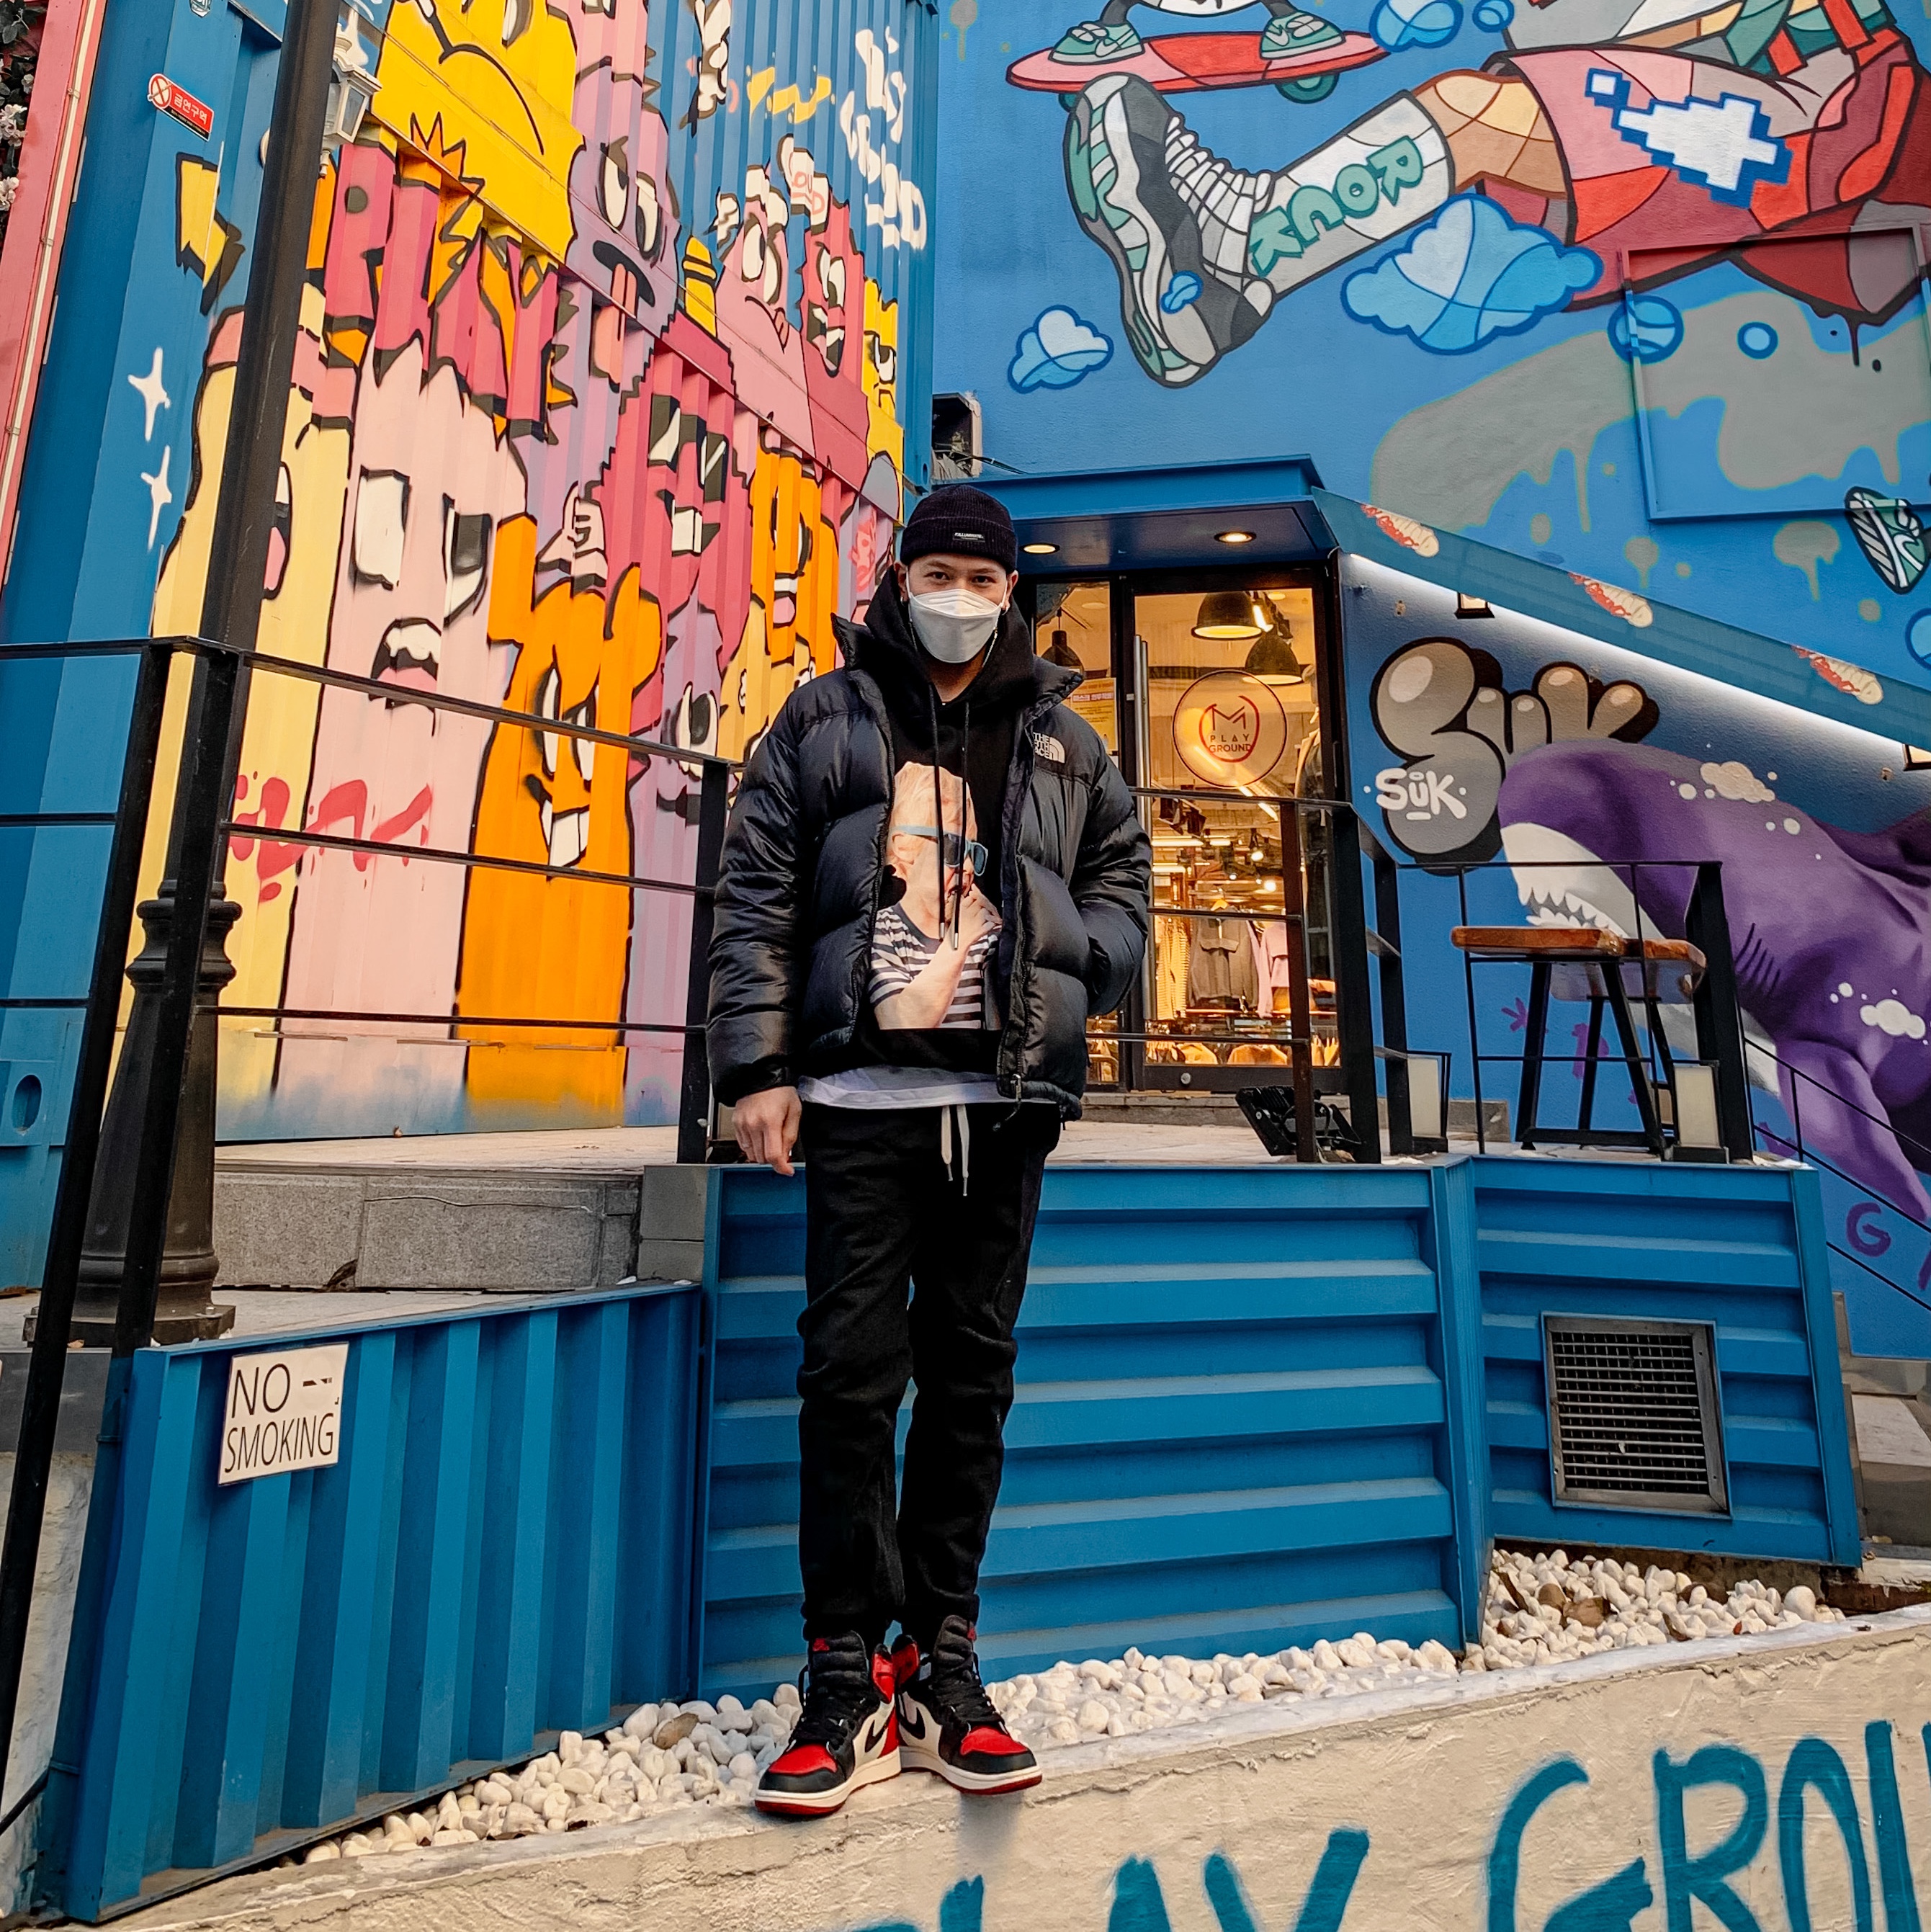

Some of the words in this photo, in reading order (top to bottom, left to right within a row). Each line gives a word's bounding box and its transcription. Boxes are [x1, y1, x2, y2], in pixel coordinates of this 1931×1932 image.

[174, 93, 207, 125] 금연구역
[1032, 732, 1050, 743] THE
[1210, 733, 1250, 743] PLAY
[1034, 740, 1050, 753] RTH
[1034, 746, 1050, 759] ACE
[1209, 743, 1252, 753] GROUND
[231, 1363, 291, 1418] NO
[224, 1413, 333, 1473] SMOKING
